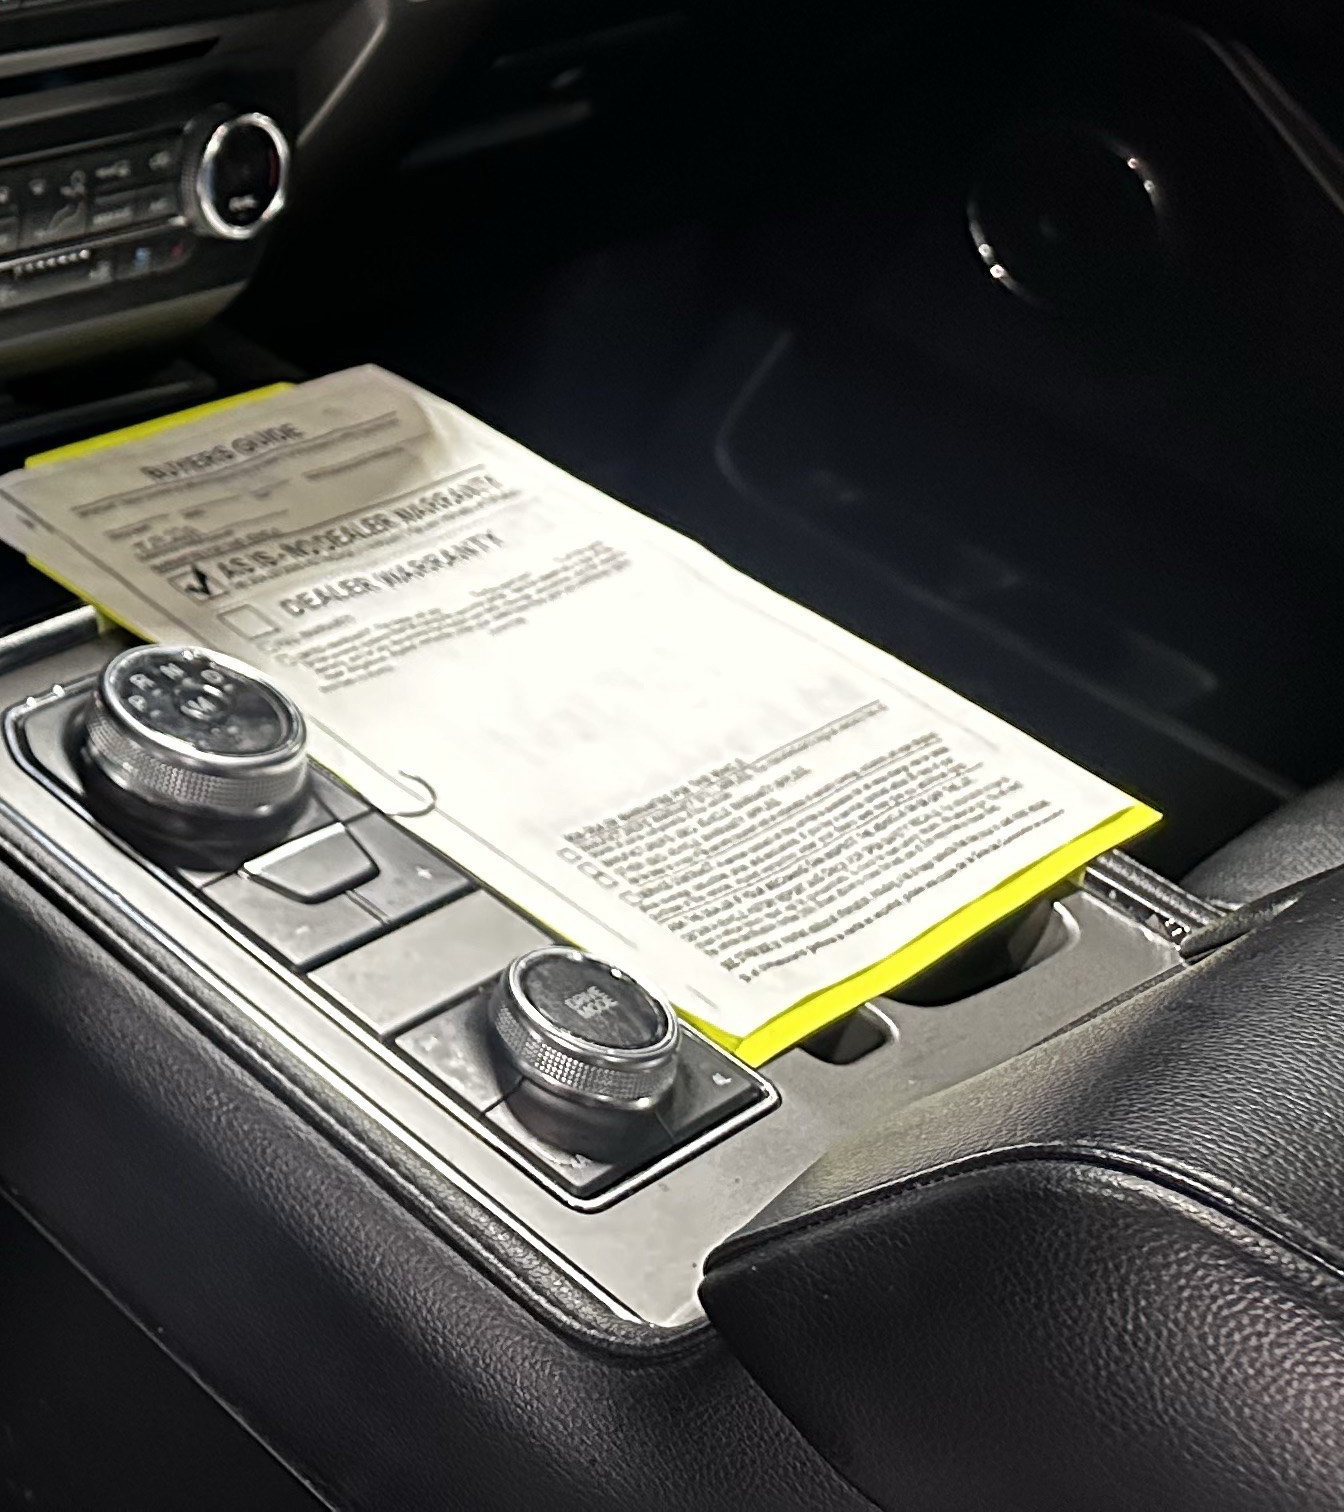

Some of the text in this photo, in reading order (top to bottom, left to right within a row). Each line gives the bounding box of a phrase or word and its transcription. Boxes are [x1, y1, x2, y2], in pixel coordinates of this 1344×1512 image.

[230, 422, 306, 456] GUIDE
[279, 576, 378, 617] DEALER
[129, 673, 156, 691] R
